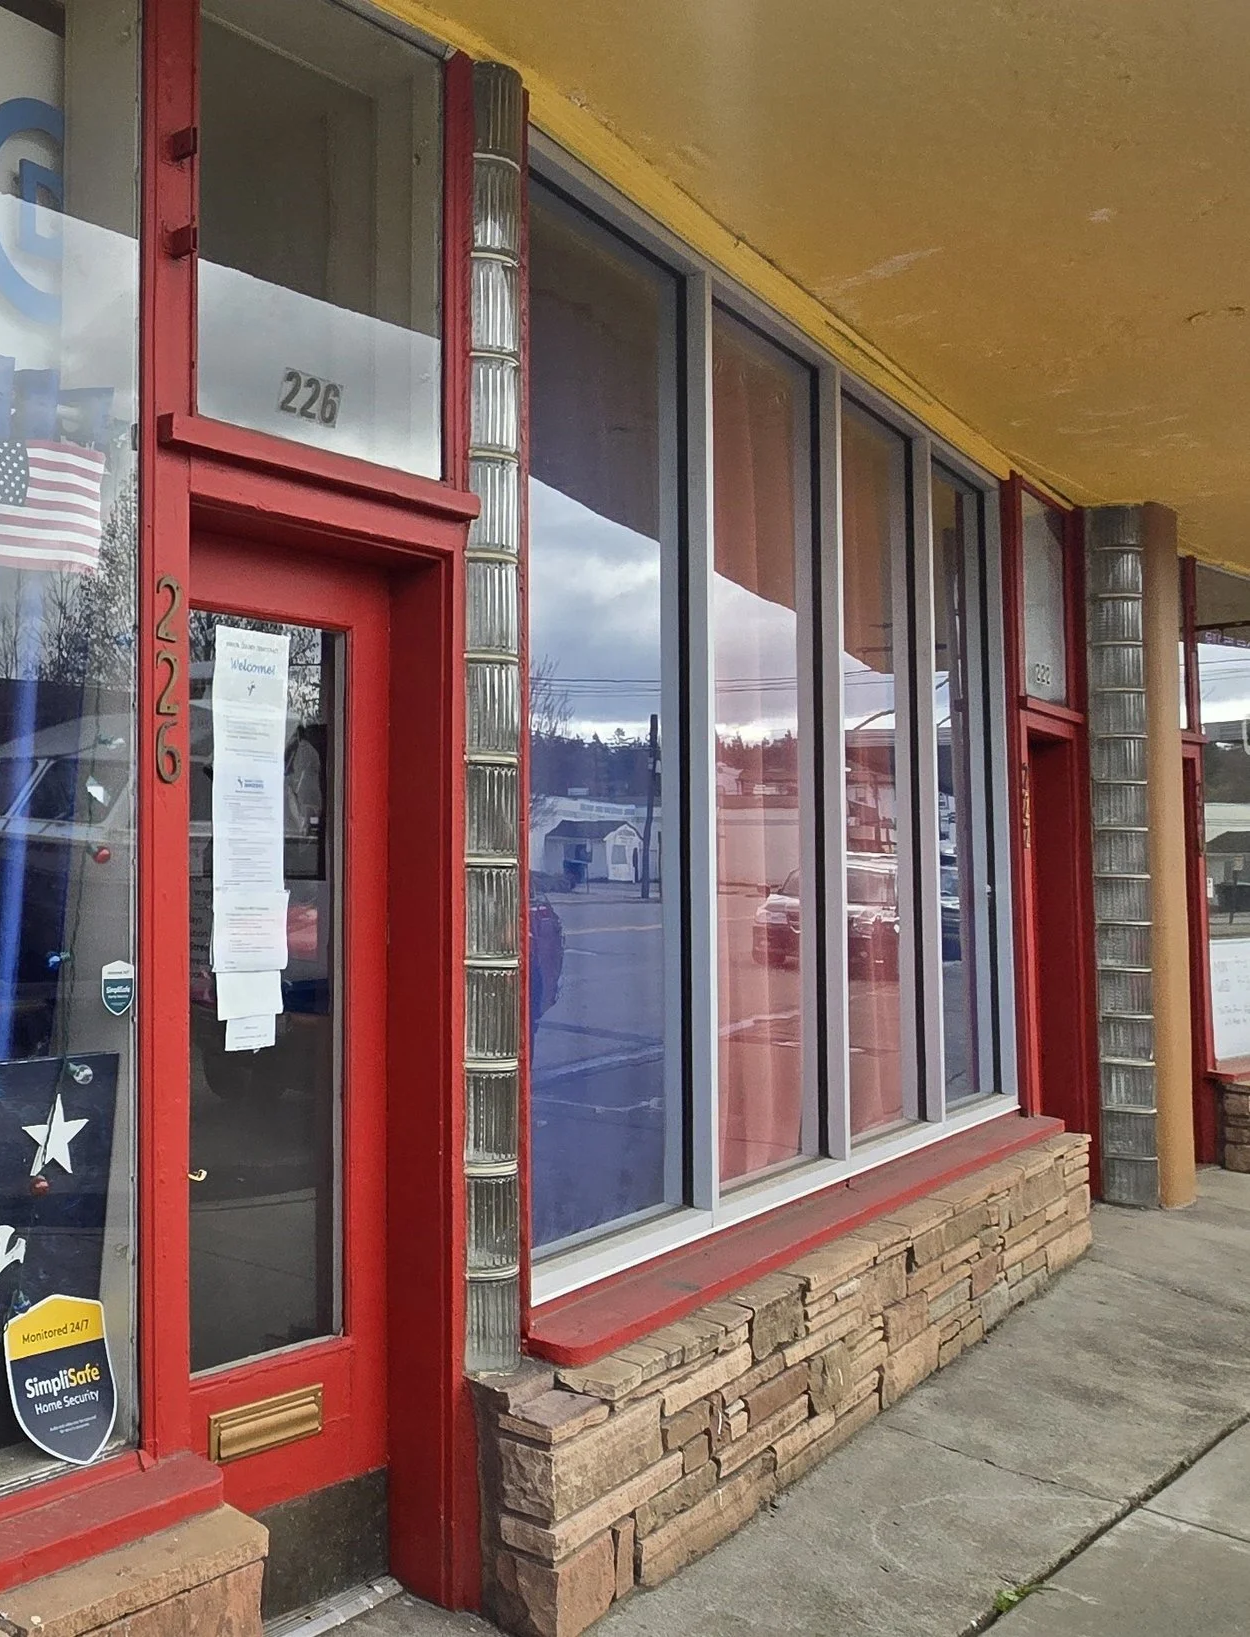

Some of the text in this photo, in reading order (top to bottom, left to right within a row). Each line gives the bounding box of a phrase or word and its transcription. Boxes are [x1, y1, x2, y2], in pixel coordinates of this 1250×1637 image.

[280, 371, 340, 424] 226
[155, 575, 182, 784] 226
[22, 1319, 89, 1344] Monitored 24/7
[25, 1363, 100, 1398] SimpliSafe
[35, 1389, 99, 1416] Home Security
